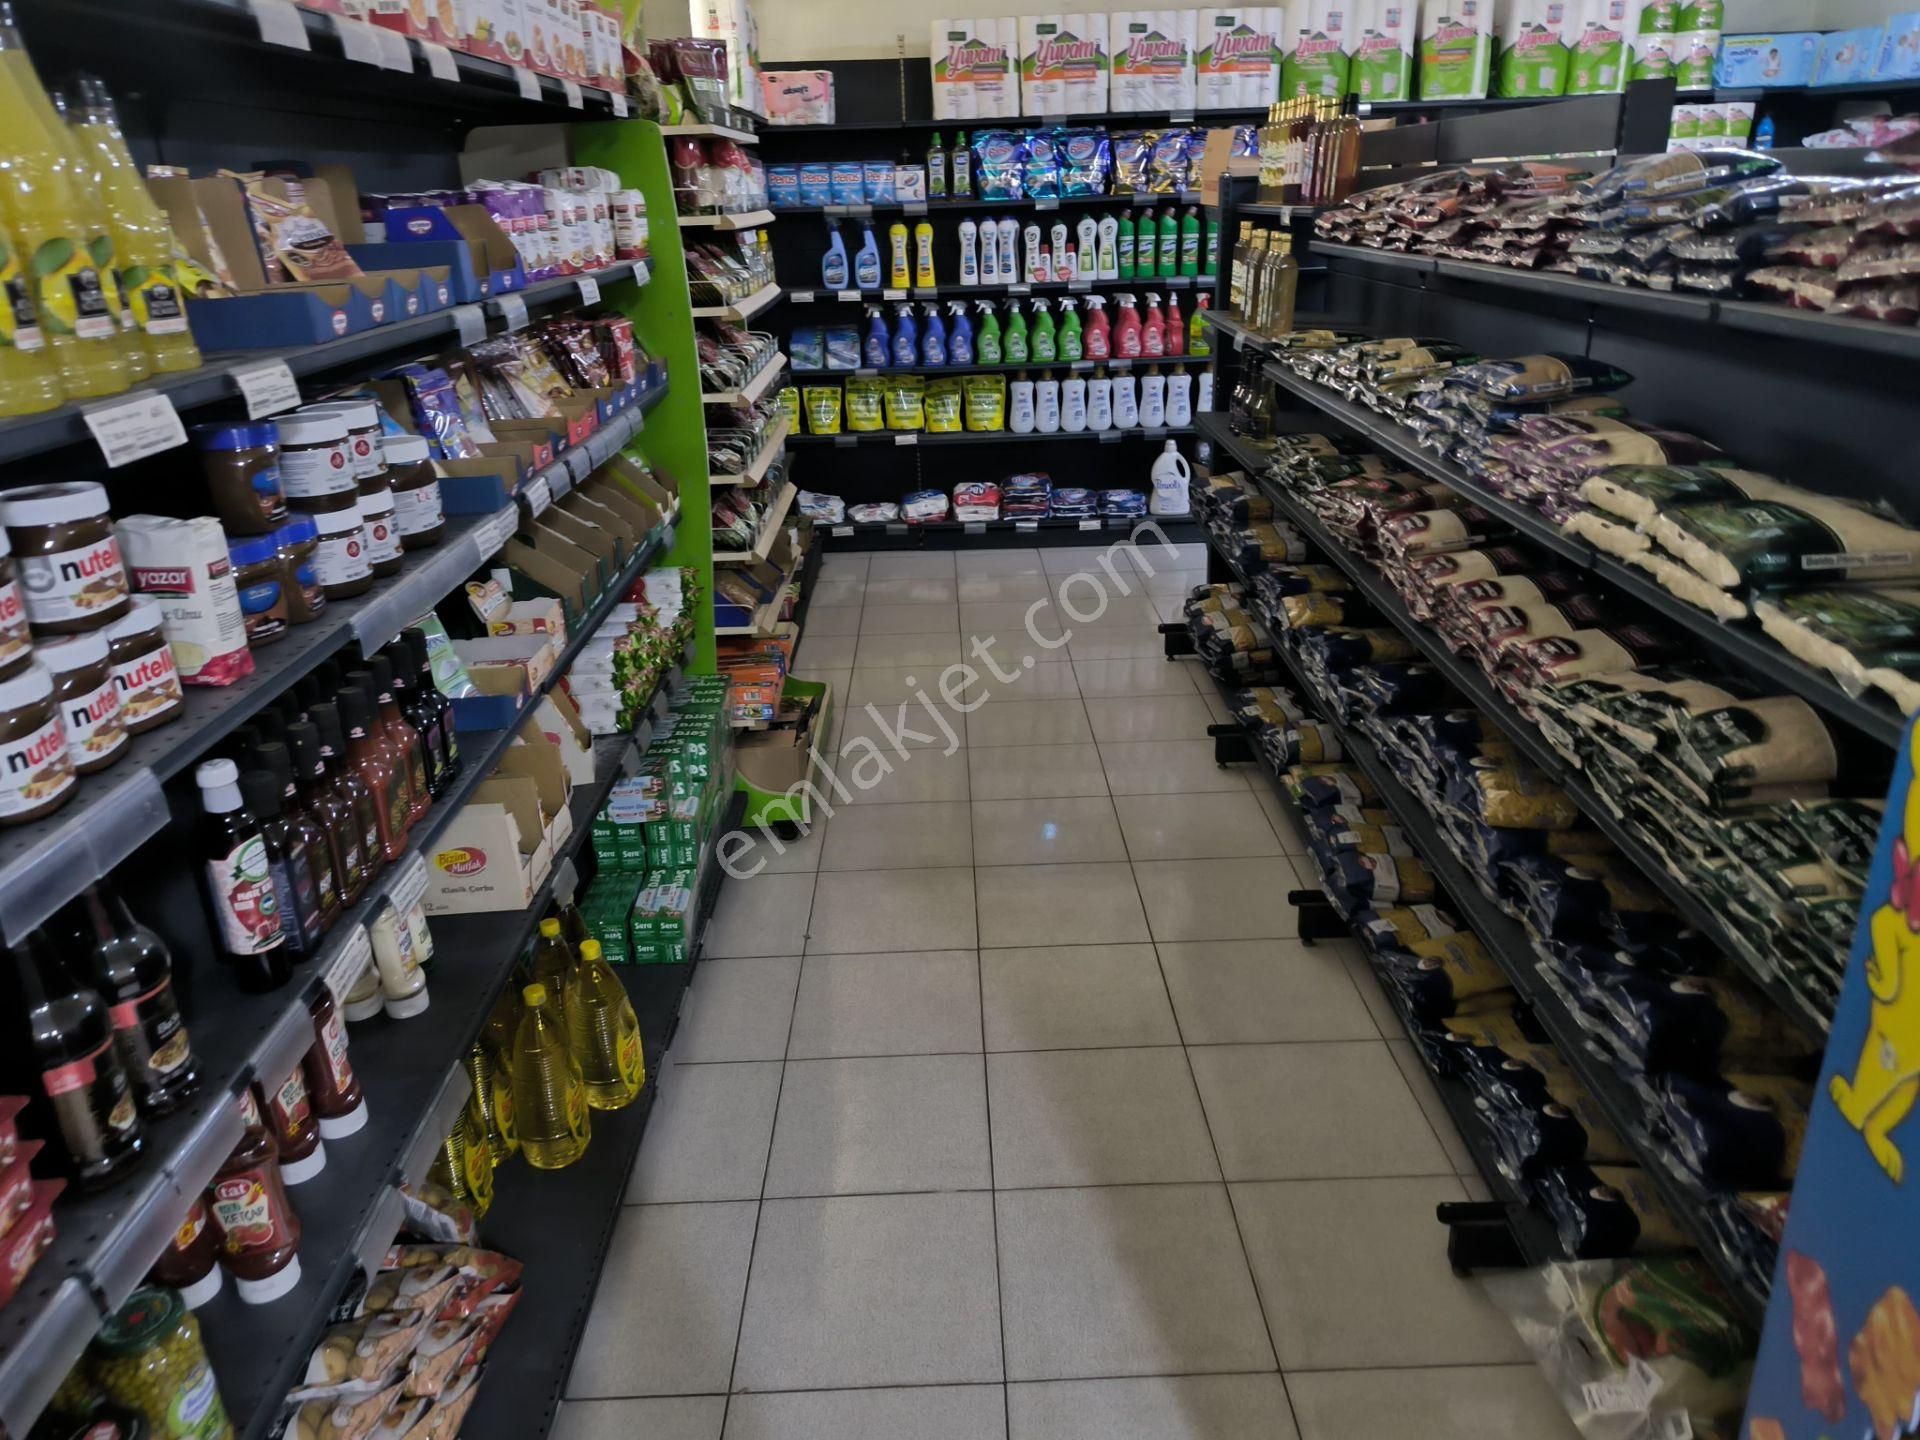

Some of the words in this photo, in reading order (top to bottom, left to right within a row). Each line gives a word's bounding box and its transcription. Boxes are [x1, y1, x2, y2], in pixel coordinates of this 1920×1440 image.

[1210, 32, 1270, 69] Yuvam
[1033, 38, 1094, 76] Yuvam
[137, 570, 187, 587] yazar
[593, 829, 611, 837] Sera
[618, 828, 636, 837] Sera
[598, 850, 615, 858] Sera
[622, 850, 640, 858] Sera
[424, 903, 433, 912] 12
[634, 922, 653, 930] Sera
[660, 922, 678, 930] Sera
[637, 945, 655, 953] Sera
[219, 1182, 247, 1198] tat
